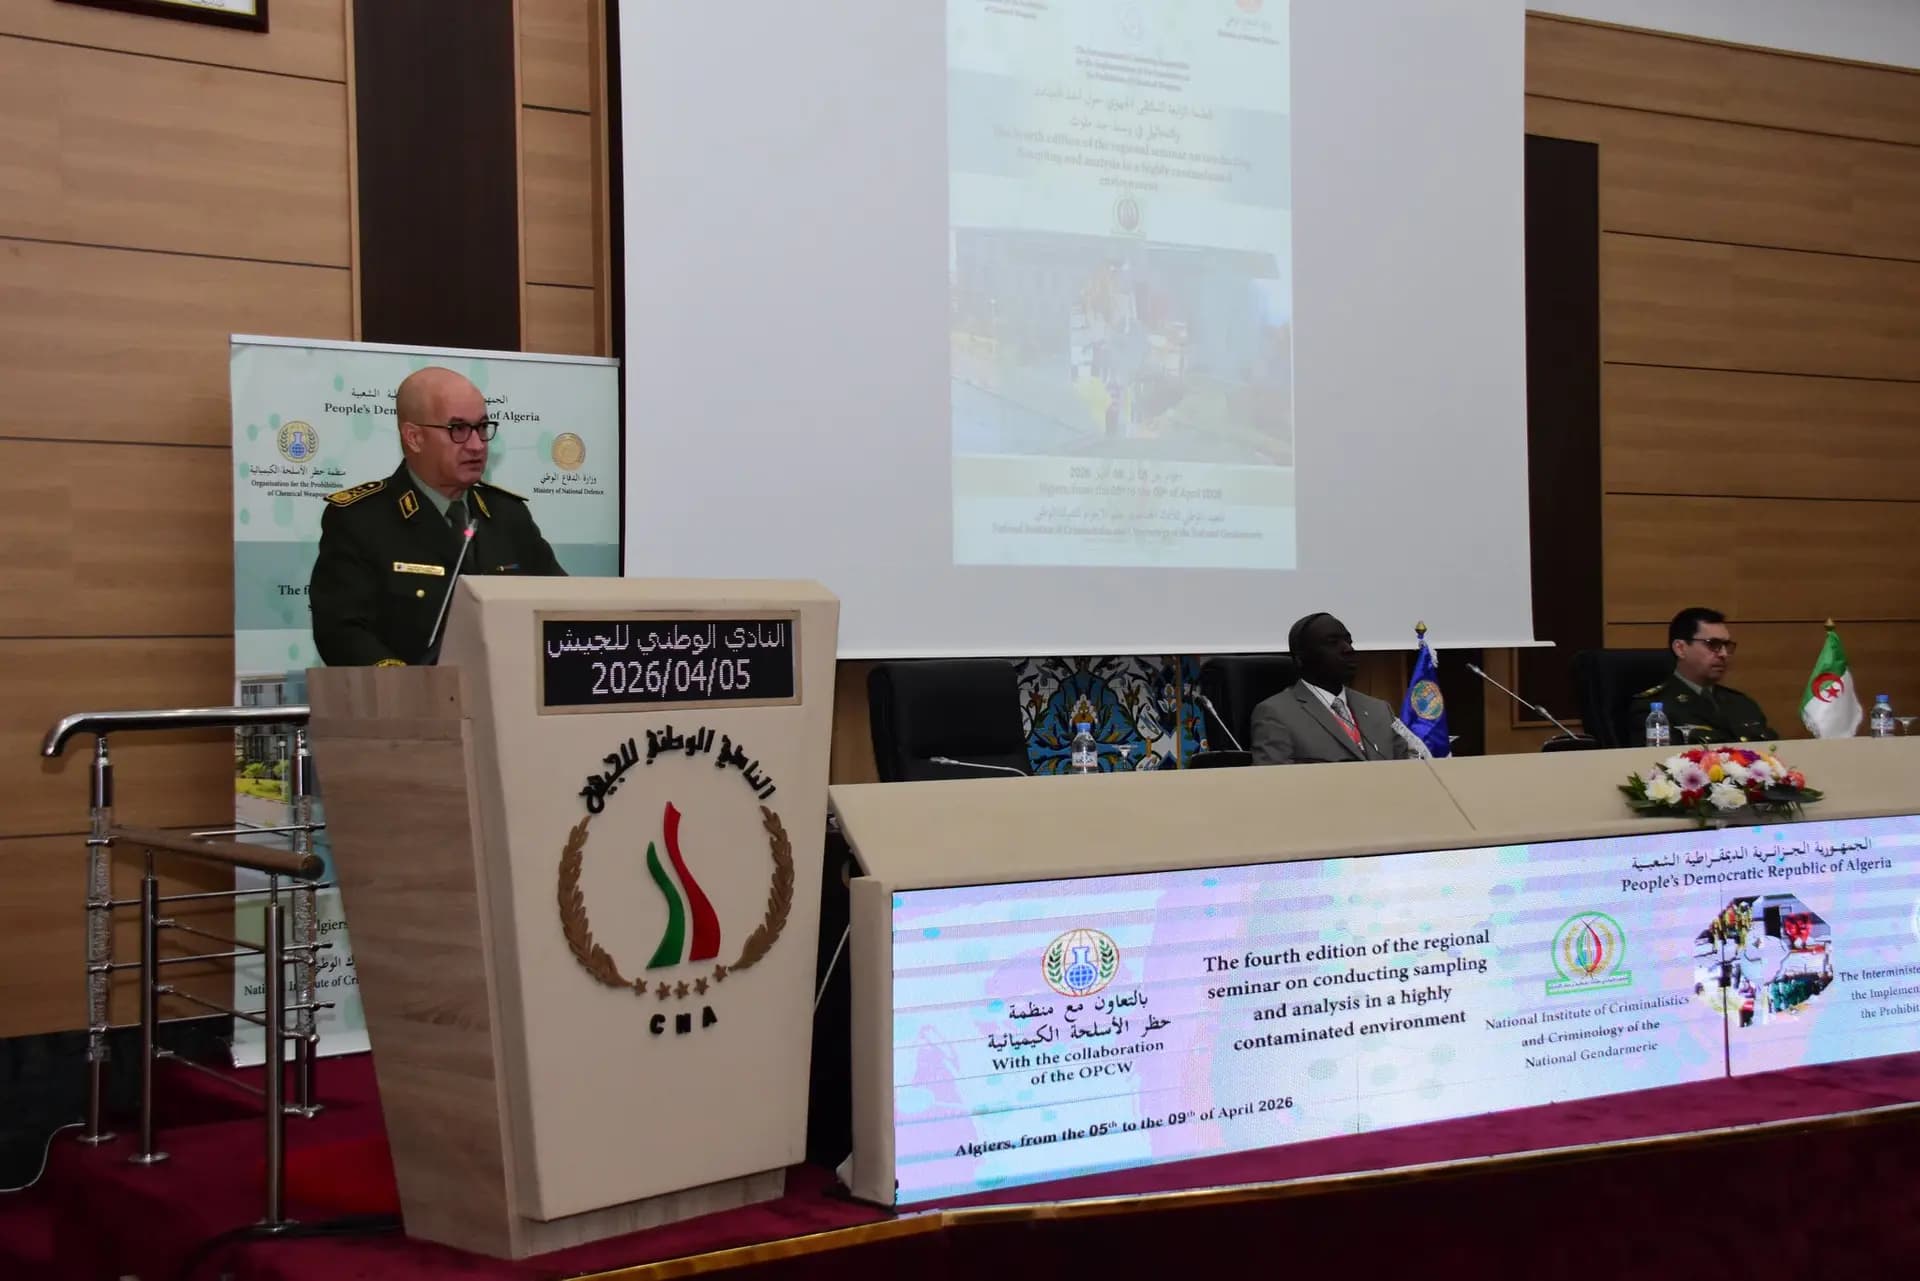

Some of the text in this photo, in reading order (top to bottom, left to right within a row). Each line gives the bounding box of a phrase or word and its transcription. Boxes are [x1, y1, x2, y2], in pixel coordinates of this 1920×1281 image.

[324, 402, 370, 416] People's
[490, 410, 541, 424] of Algeria
[277, 584, 301, 596] The
[547, 623, 785, 658] النادي الوطني للجيش
[591, 658, 751, 698] 2026/04/05
[646, 724, 716, 765] الوطني
[1631, 837, 1872, 871] الجمهورية الجزائرية الديمقراطية الشعبية
[1622, 857, 1893, 893] People's Democratic Republic of Algeria
[1203, 929, 1490, 974] The fourth edition of the regional
[331, 975, 343, 988] of
[1207, 956, 1488, 1000] seminar on conducting sampling
[1840, 970, 1859, 982] The
[1008, 989, 1149, 1023] بالتعاون مع منظمة
[1253, 985, 1453, 1021] and analysis in a highly
[1851, 988, 1867, 1000] the
[1485, 994, 1690, 1031] National Institute of Criminalistics
[1861, 1005, 1876, 1018] the
[987, 1014, 1172, 1052] حظر الأسلحة الكيميائية
[1233, 1010, 1467, 1051] contaminated environment
[1521, 1018, 1661, 1048] and Criminology of the
[992, 1040, 1165, 1072] With the collaboration
[1525, 1040, 1659, 1070] National Gendarmerie
[1030, 1061, 1134, 1086] of the OPCW
[955, 1136, 1017, 1158] Algiers,
[1019, 1131, 1058, 1149] from
[1062, 1126, 1086, 1142] the
[1122, 1118, 1137, 1133] to
[1140, 1114, 1164, 1130] the
[1200, 1107, 1215, 1122] of
[1218, 1103, 1255, 1121] April
[1258, 1096, 1294, 1113] 2026
